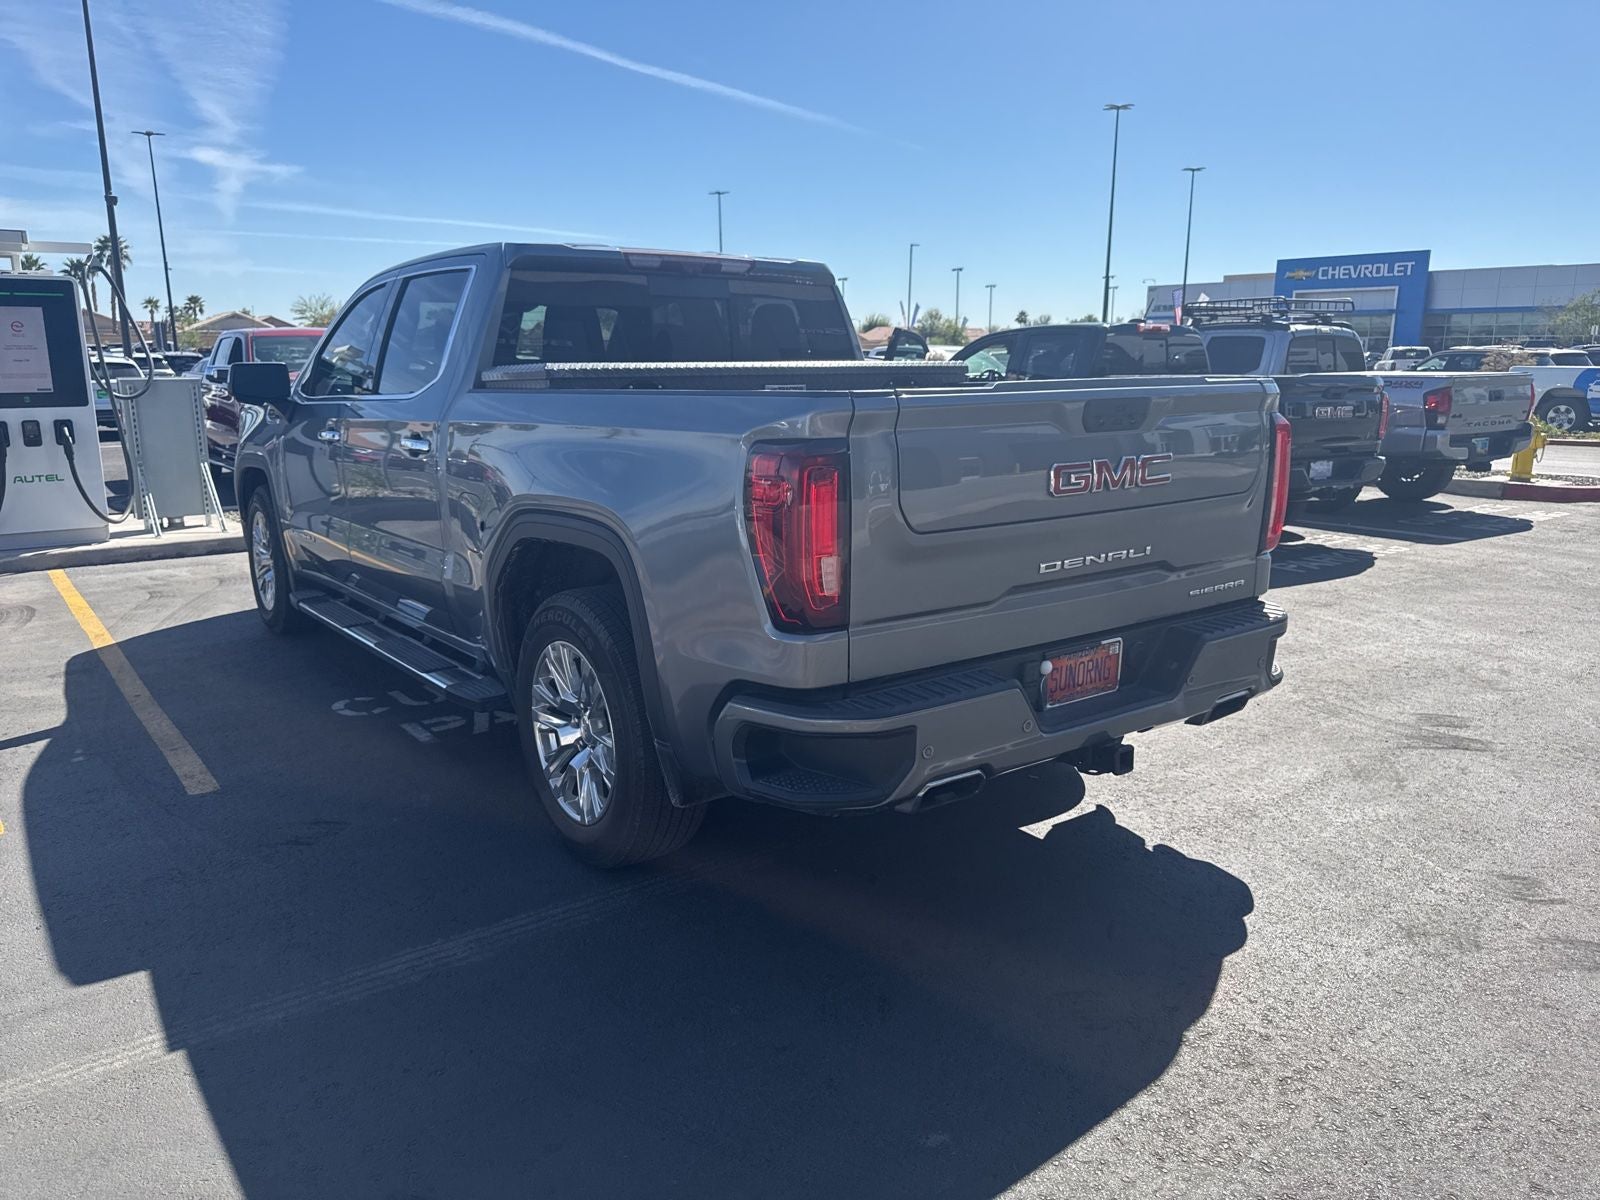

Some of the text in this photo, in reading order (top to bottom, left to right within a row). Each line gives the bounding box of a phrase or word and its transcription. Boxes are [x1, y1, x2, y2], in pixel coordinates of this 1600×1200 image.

[1318, 262, 1416, 280] CHEVROLET
[1315, 405, 1354, 418] GMC
[1465, 419, 1512, 428] TACOMA
[13, 474, 65, 484] AUTEL
[1050, 452, 1174, 497] GMC
[1039, 545, 1152, 574] DENALI
[1189, 579, 1246, 596] SIERRA
[532, 609, 594, 652] HERCULES
[1049, 656, 1112, 694] SUNORNG
